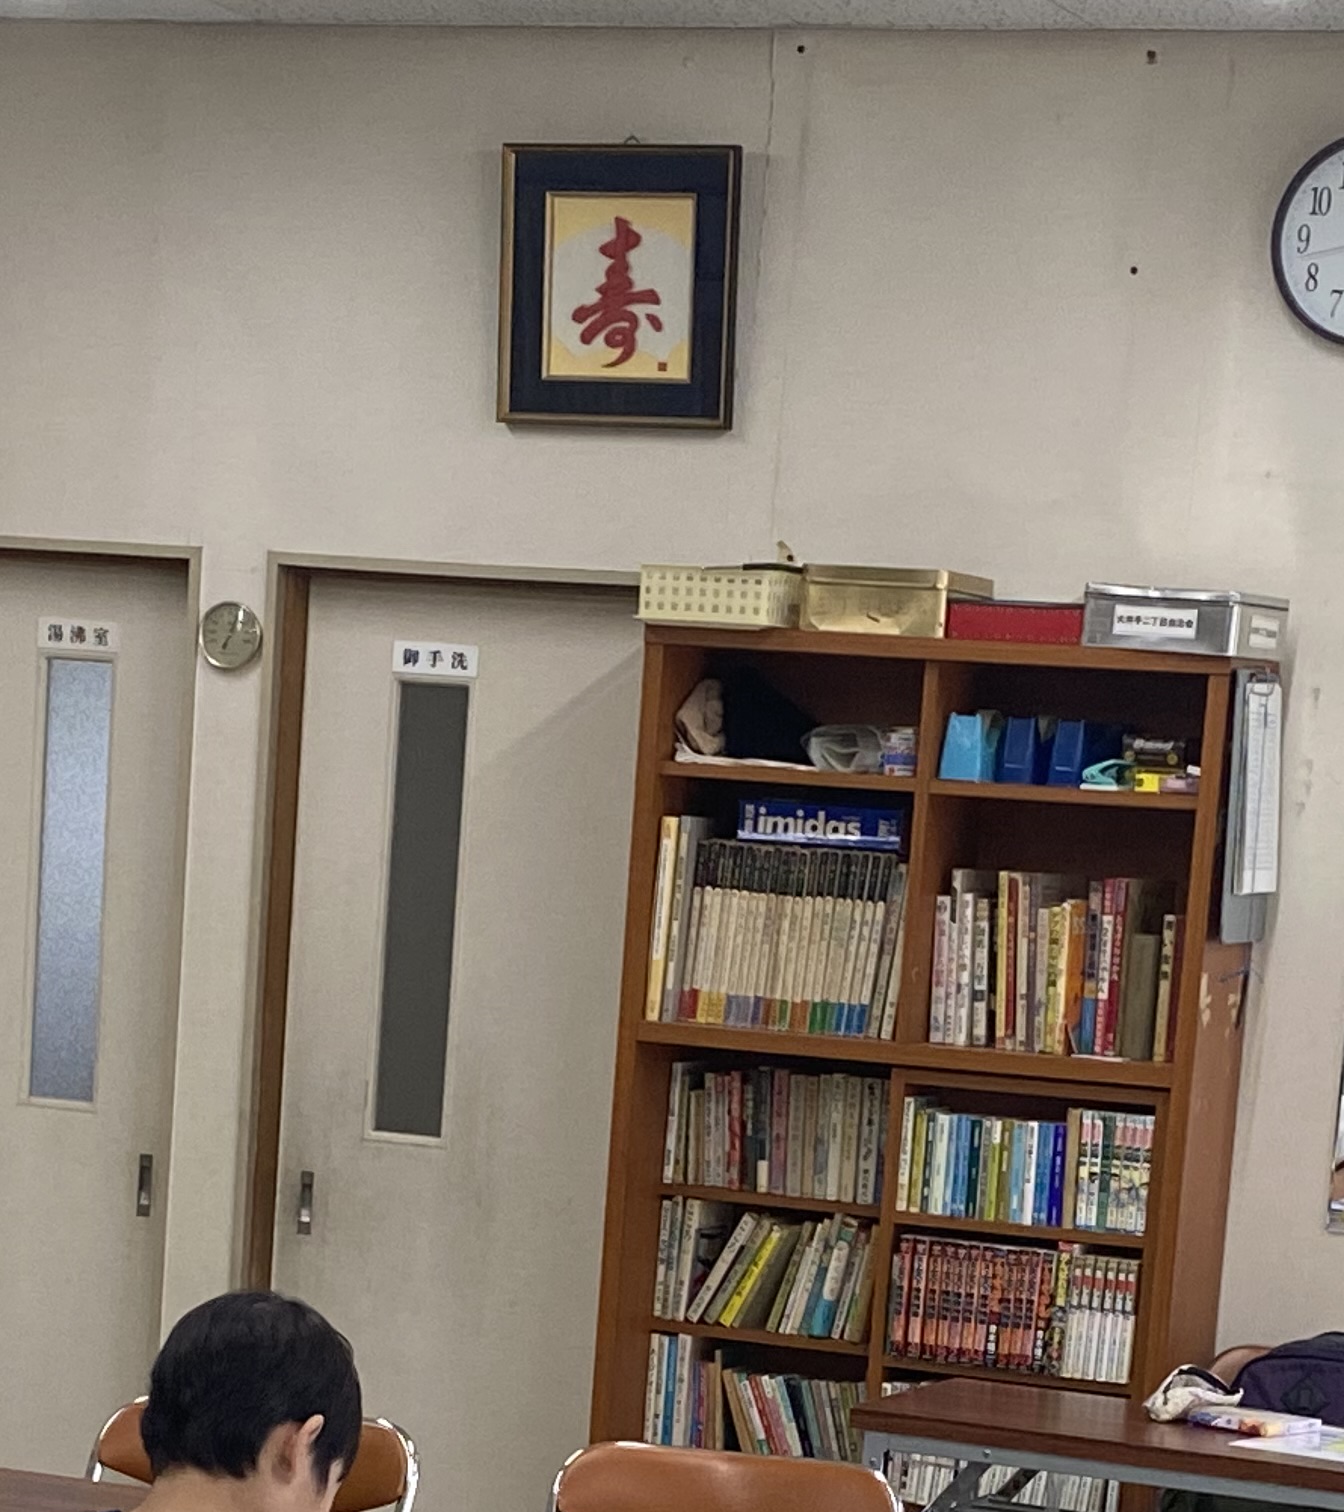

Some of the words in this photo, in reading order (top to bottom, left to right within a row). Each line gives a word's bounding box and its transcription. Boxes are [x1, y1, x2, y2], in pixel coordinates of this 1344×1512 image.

[1309, 186, 1332, 216] 10
[1297, 223, 1311, 254] 9
[571, 215, 664, 368] 寿
[1305, 262, 1319, 292] 8
[1329, 289, 1344, 318] 7
[403, 648, 468, 670] 御手洗
[757, 806, 862, 838] imidas
